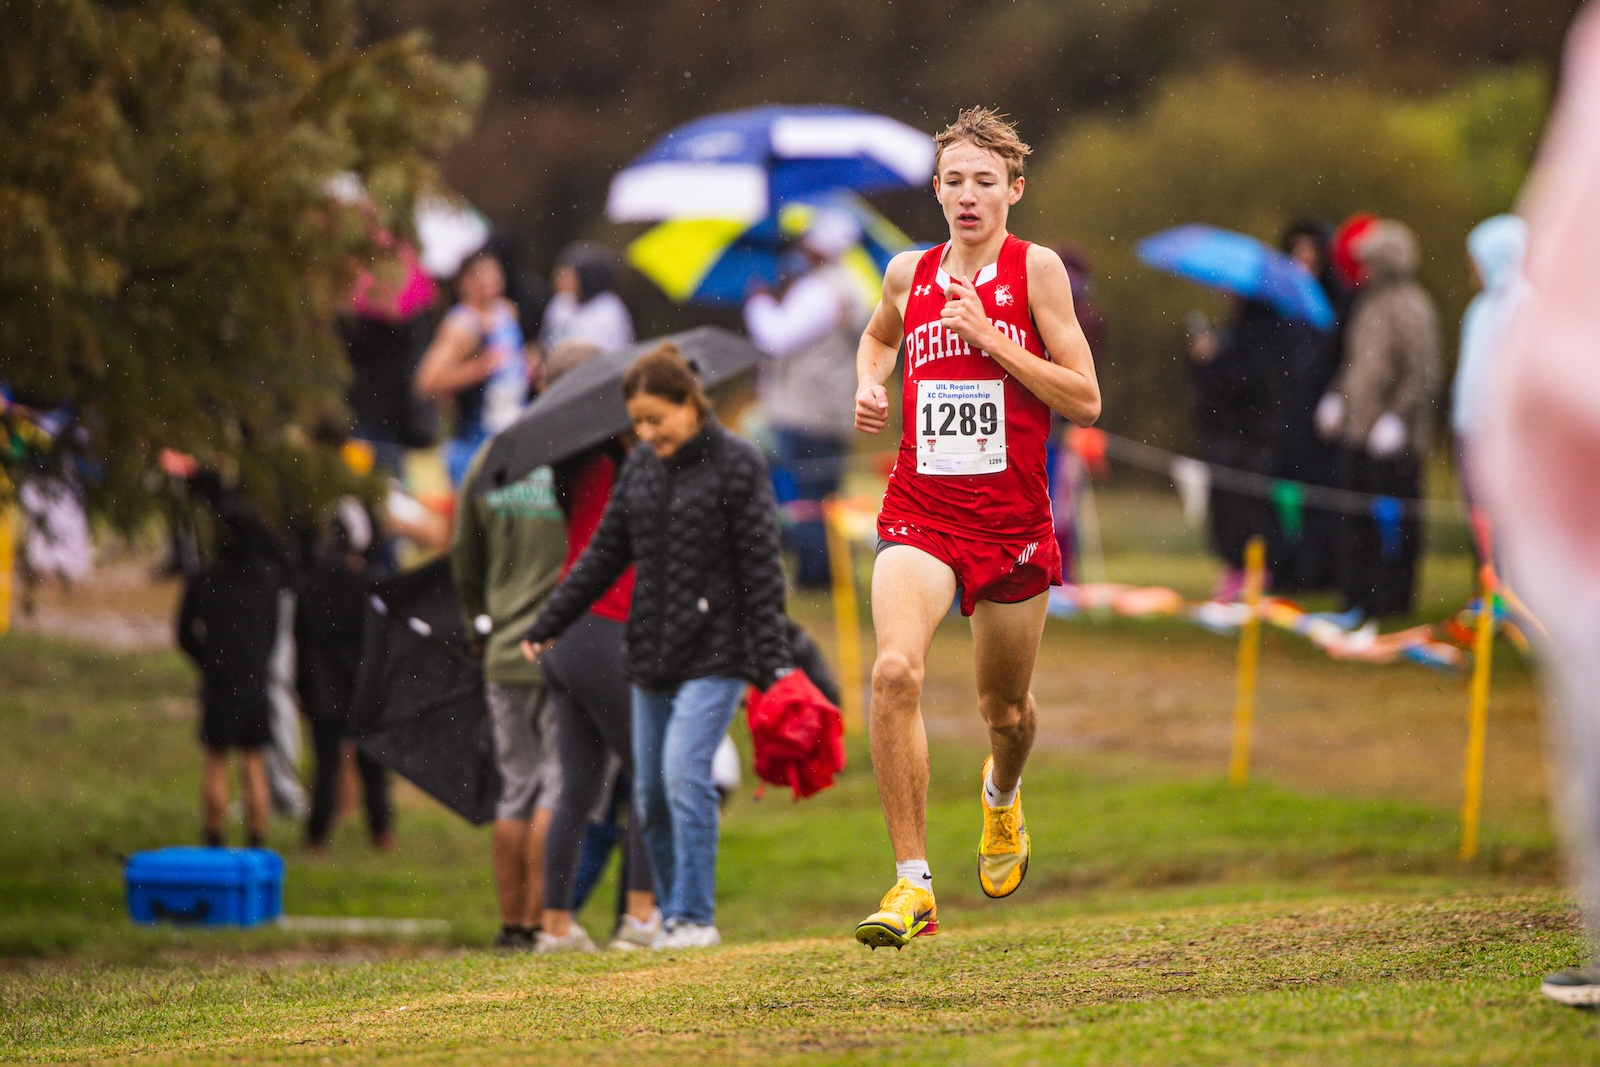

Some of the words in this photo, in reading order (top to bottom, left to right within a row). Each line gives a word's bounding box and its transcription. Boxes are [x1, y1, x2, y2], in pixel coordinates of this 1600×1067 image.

[906, 318, 1026, 378] PERRON
[950, 384, 975, 392] Region
[922, 402, 998, 436] 1289
